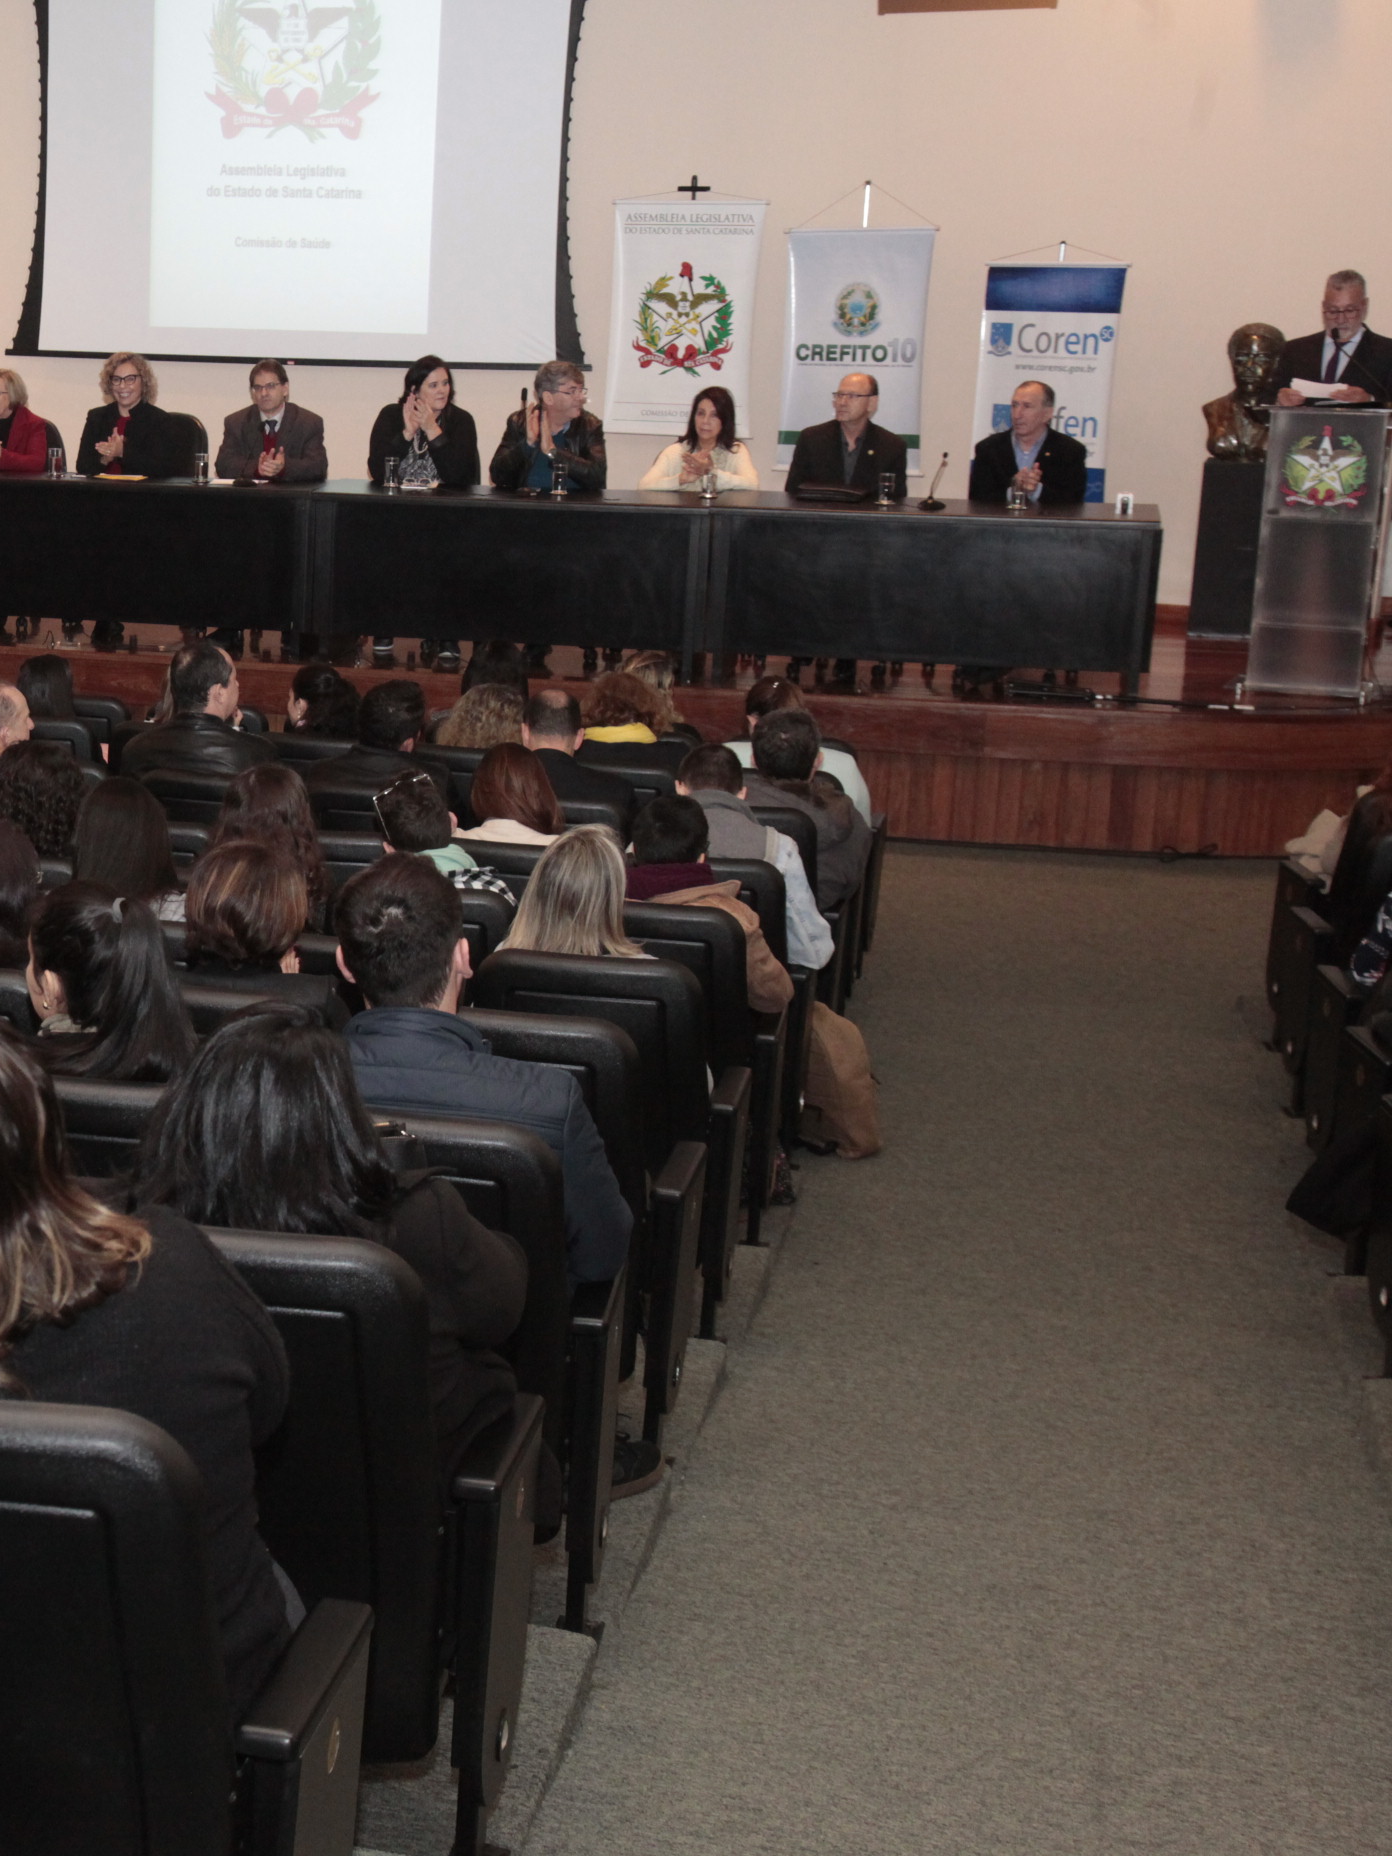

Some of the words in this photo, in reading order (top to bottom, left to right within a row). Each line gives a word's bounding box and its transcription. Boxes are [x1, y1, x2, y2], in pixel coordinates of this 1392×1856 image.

[219, 163, 283, 177] Assembleia
[286, 164, 347, 180] Legislativa
[206, 184, 221, 198] do
[223, 185, 262, 198] Estado
[264, 185, 279, 198] de
[281, 185, 313, 199] Santa
[315, 186, 363, 199] Catarina
[625, 212, 687, 223] ASSEMBLEIA
[689, 213, 755, 224] LEGISLATIVA
[623, 226, 638, 235] DO
[639, 226, 670, 235] ESTADO
[671, 227, 683, 235] DE
[685, 227, 710, 235] SANTA
[712, 227, 755, 236] CATARINA
[284, 237, 298, 249] de
[1017, 323, 1099, 355] Coren
